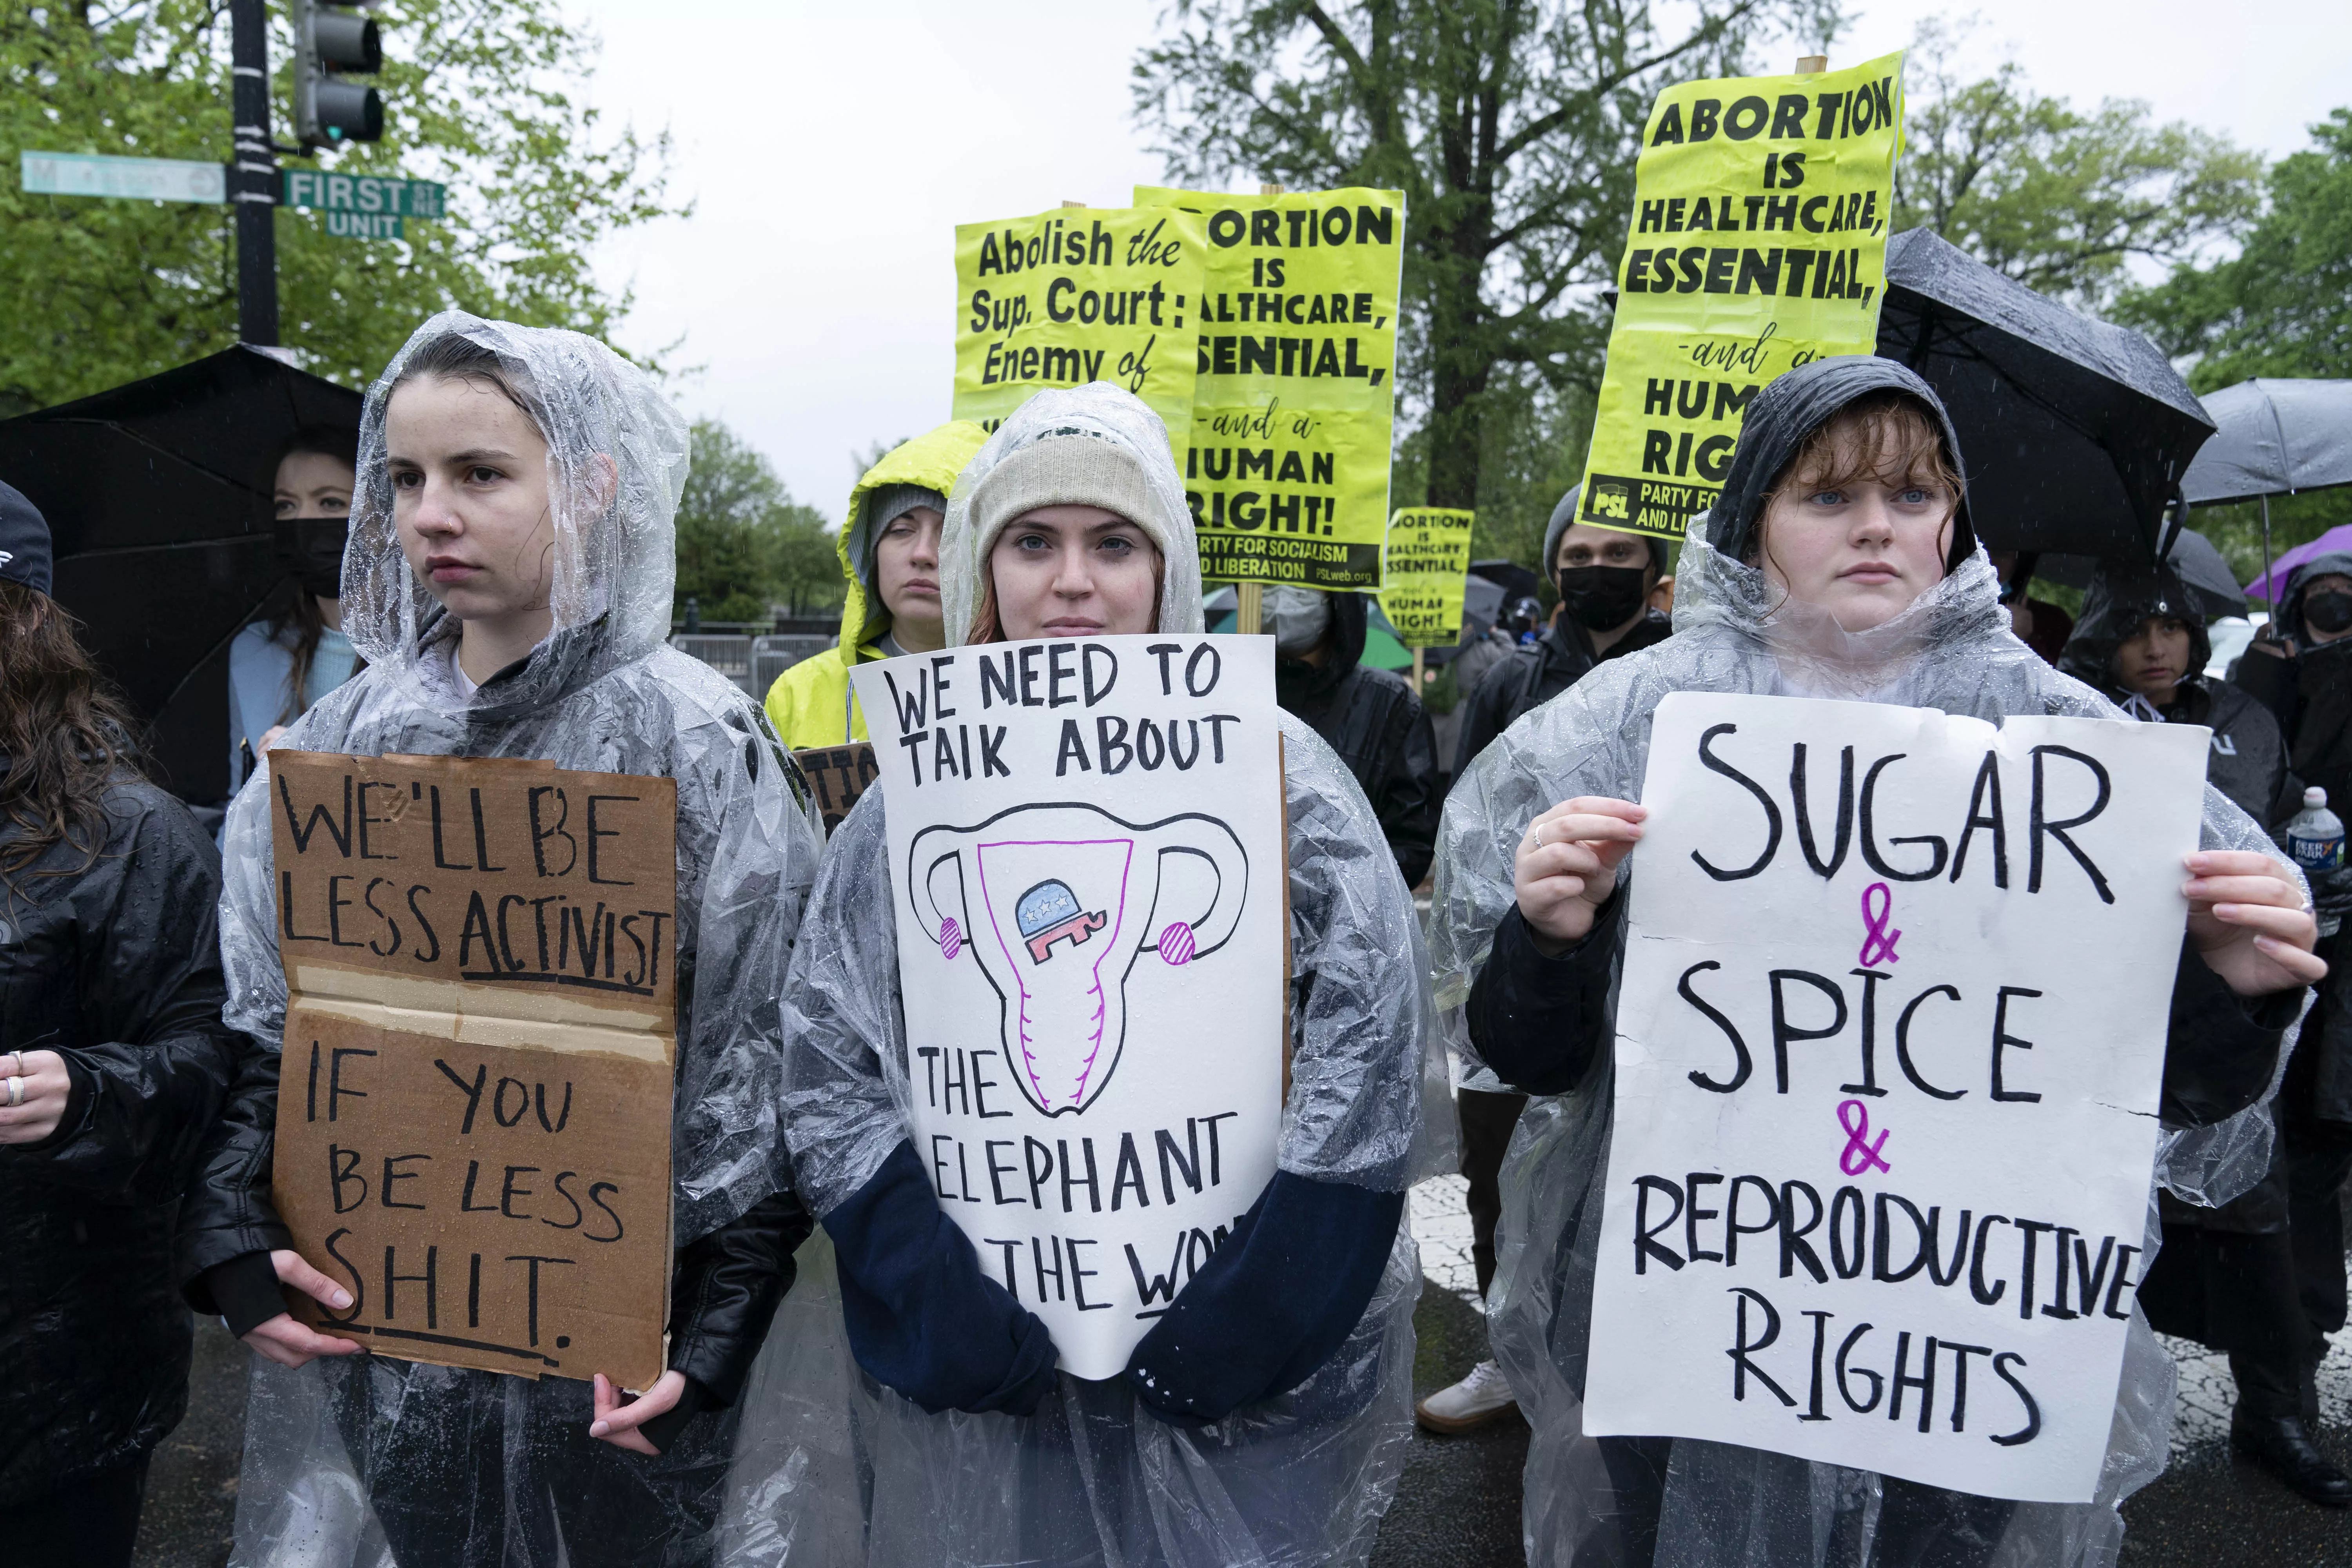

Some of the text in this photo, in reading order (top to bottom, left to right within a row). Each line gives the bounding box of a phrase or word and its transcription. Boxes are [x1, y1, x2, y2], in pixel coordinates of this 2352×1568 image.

[1651, 76, 1892, 147] ABORTION
[290, 172, 406, 212] FIRST
[1763, 152, 1806, 189] IS
[328, 212, 398, 236] UNIT
[1179, 206, 1392, 248] ORTION
[1638, 191, 1883, 237] HEALTHCARE,
[978, 218, 1180, 277] Abolish the
[1252, 258, 1285, 288] IS
[1047, 278, 1185, 328] Court:
[1625, 247, 1875, 309] ESSENTIAL,
[1200, 293, 1387, 329] ALTHCARE,
[982, 334, 1155, 394] Enemy of
[1197, 335, 1386, 386] SENTIAL,
[1644, 378, 1760, 422] HUM
[1641, 429, 1736, 482] RIG
[1185, 491, 1335, 536] RIGHT!
[1393, 515, 1469, 528] ORTION
[1593, 492, 1629, 519] PSL
[1635, 507, 1668, 529] AND
[1641, 483, 1720, 509] PARTY FO
[1200, 536, 1348, 563] RTY FOR SOCIALISM
[1418, 532, 1430, 542] IS
[1216, 558, 1305, 579] LIBERATION
[1316, 567, 1372, 583] PSLweb.org
[1387, 559, 1463, 575] SSENTIAL,
[883, 641, 1221, 735] WE NEED TO
[899, 714, 1241, 787] TALK ABOUT
[278, 774, 640, 886] WE'LL BE
[1691, 722, 2115, 905] SUGAR
[282, 871, 672, 986] LESS ACTIVIST
[1859, 882, 1902, 968] &
[1677, 960, 2043, 1103] SPICE
[308, 1040, 572, 1134] IF YOU
[917, 1047, 1013, 1118] THE
[932, 1111, 1238, 1213] ELEPHANT
[1837, 1099, 1891, 1176] &
[329, 1143, 624, 1243] BE LESS
[984, 1214, 1245, 1311] THE WO
[1632, 1172, 2142, 1321] REPRODUCTIVE
[315, 1228, 577, 1348] SHIT.
[1725, 1287, 2041, 1447] RIGHTS
